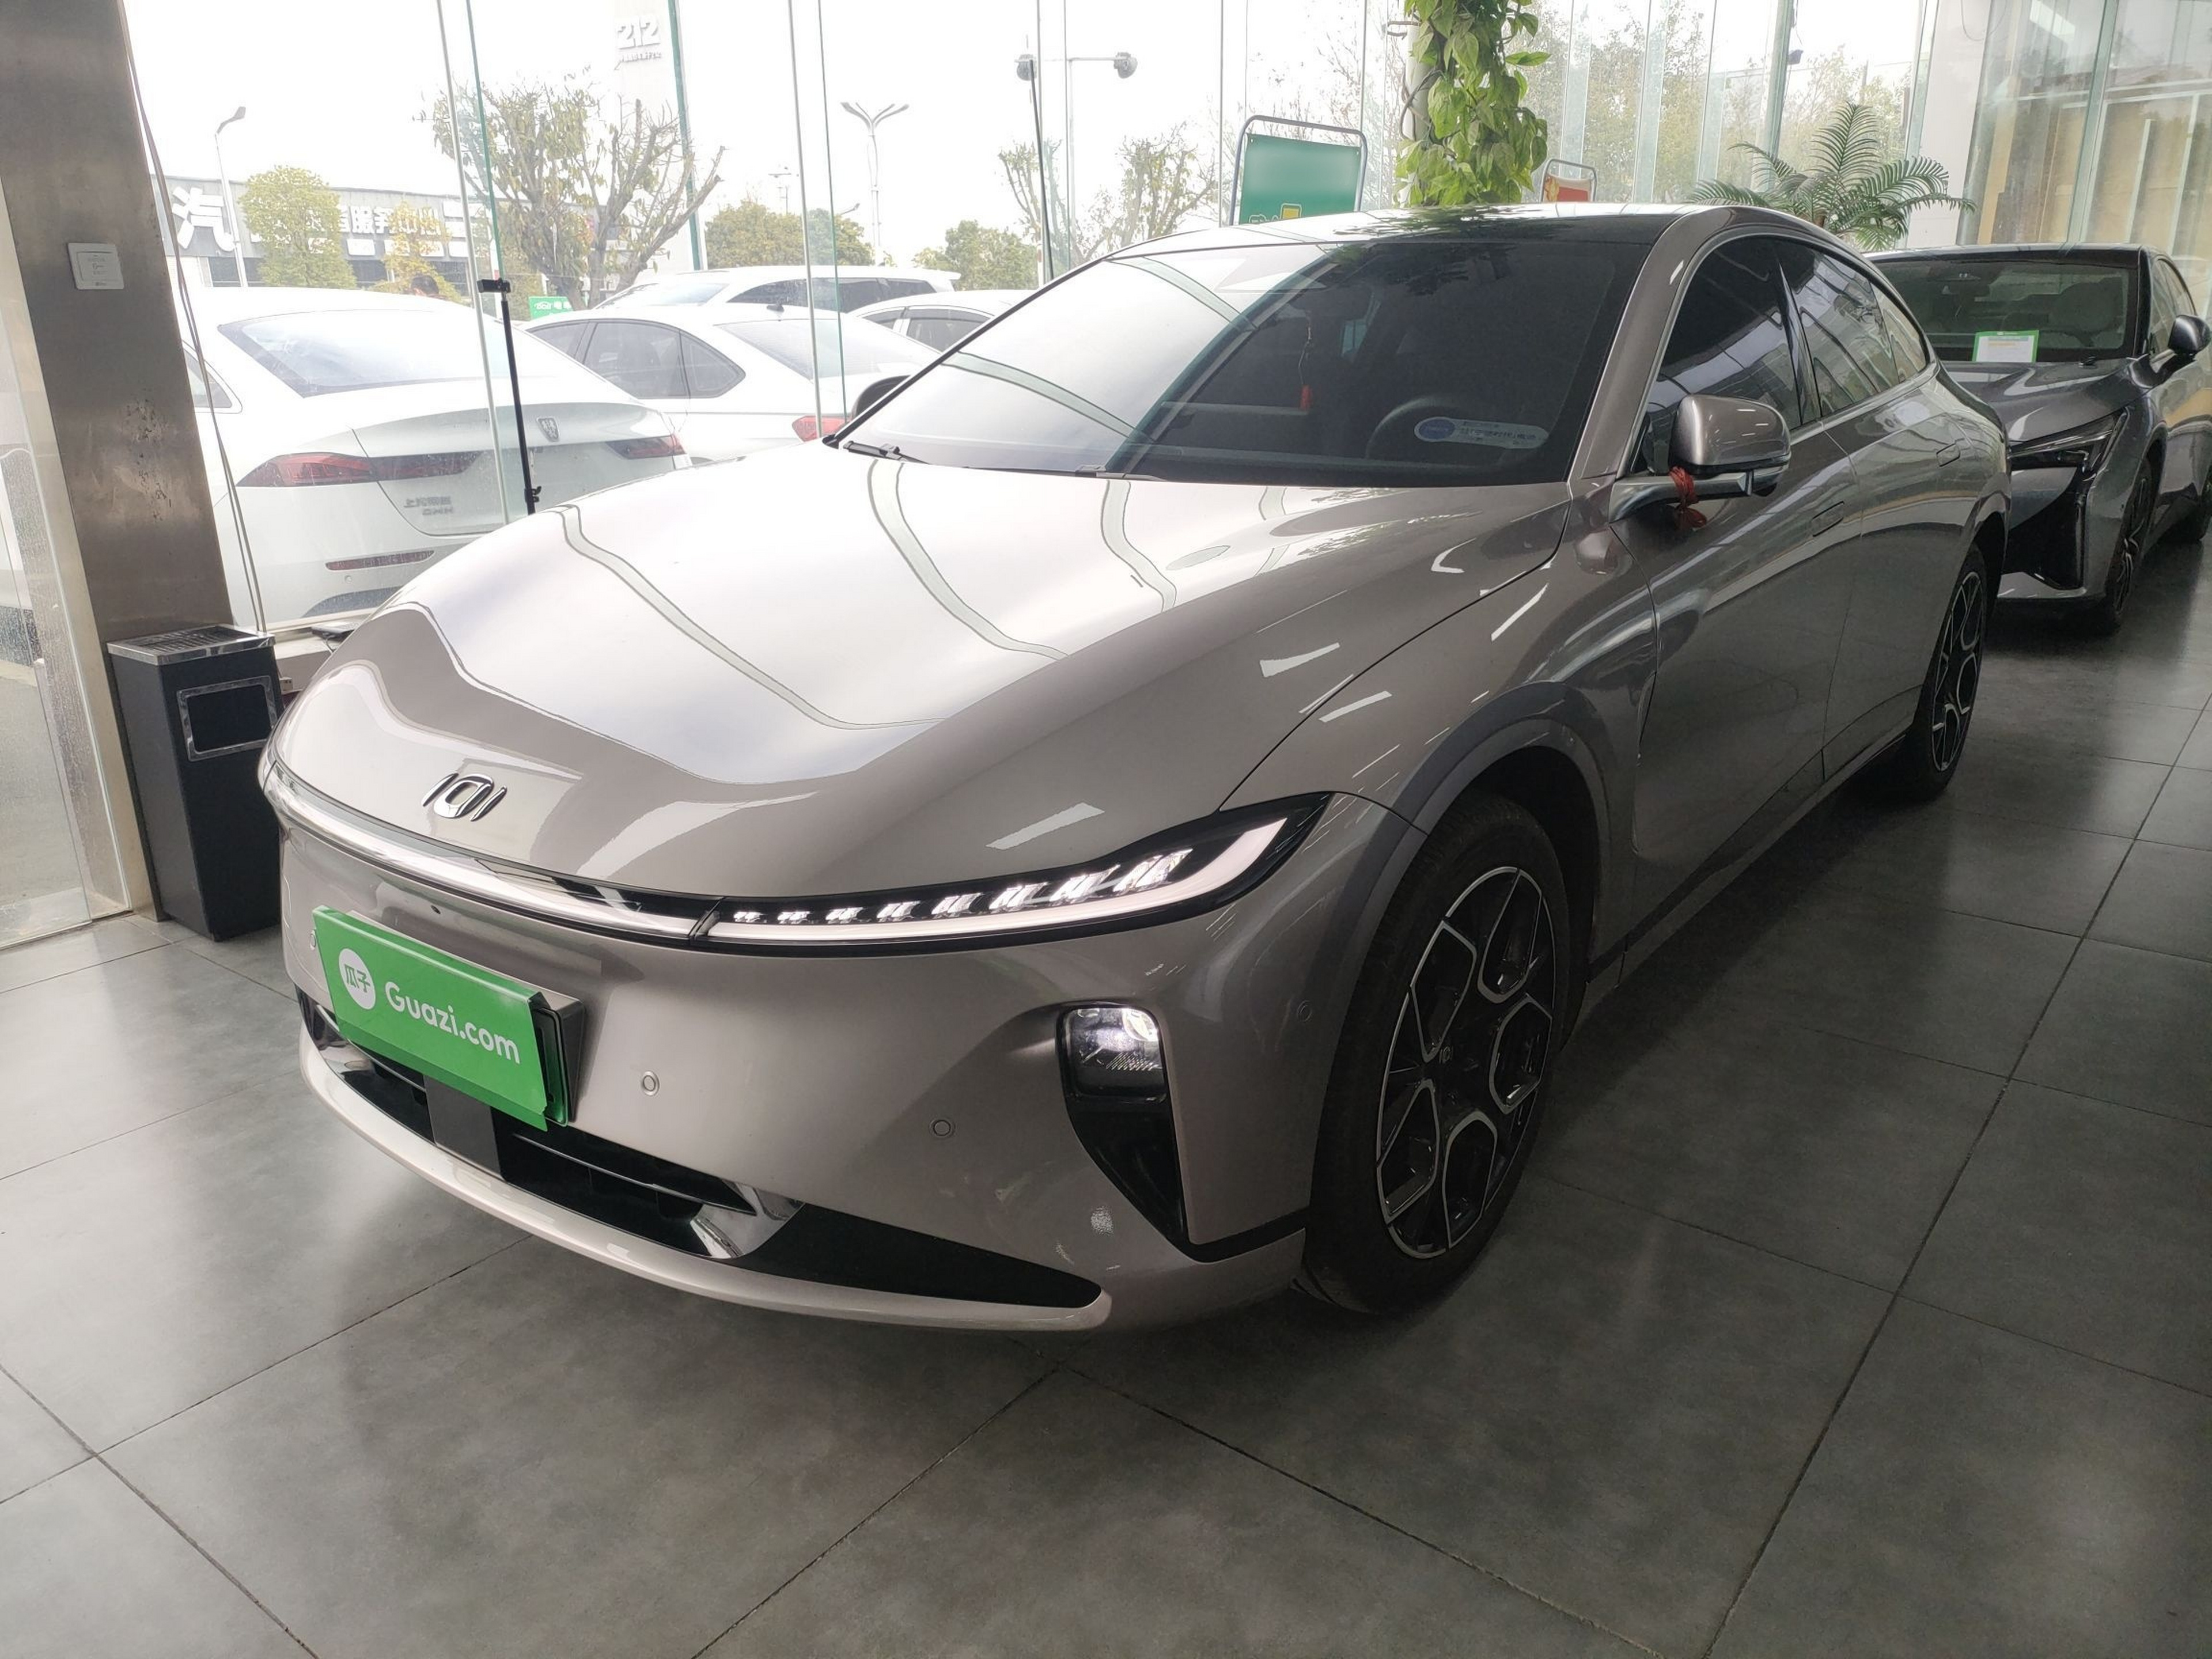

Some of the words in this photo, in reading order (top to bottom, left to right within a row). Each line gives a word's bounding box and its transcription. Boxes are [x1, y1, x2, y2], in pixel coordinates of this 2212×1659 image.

[617, 16, 661, 49] 212
[344, 964, 370, 993] 瓜子
[385, 982, 520, 1064] Guazi.com
